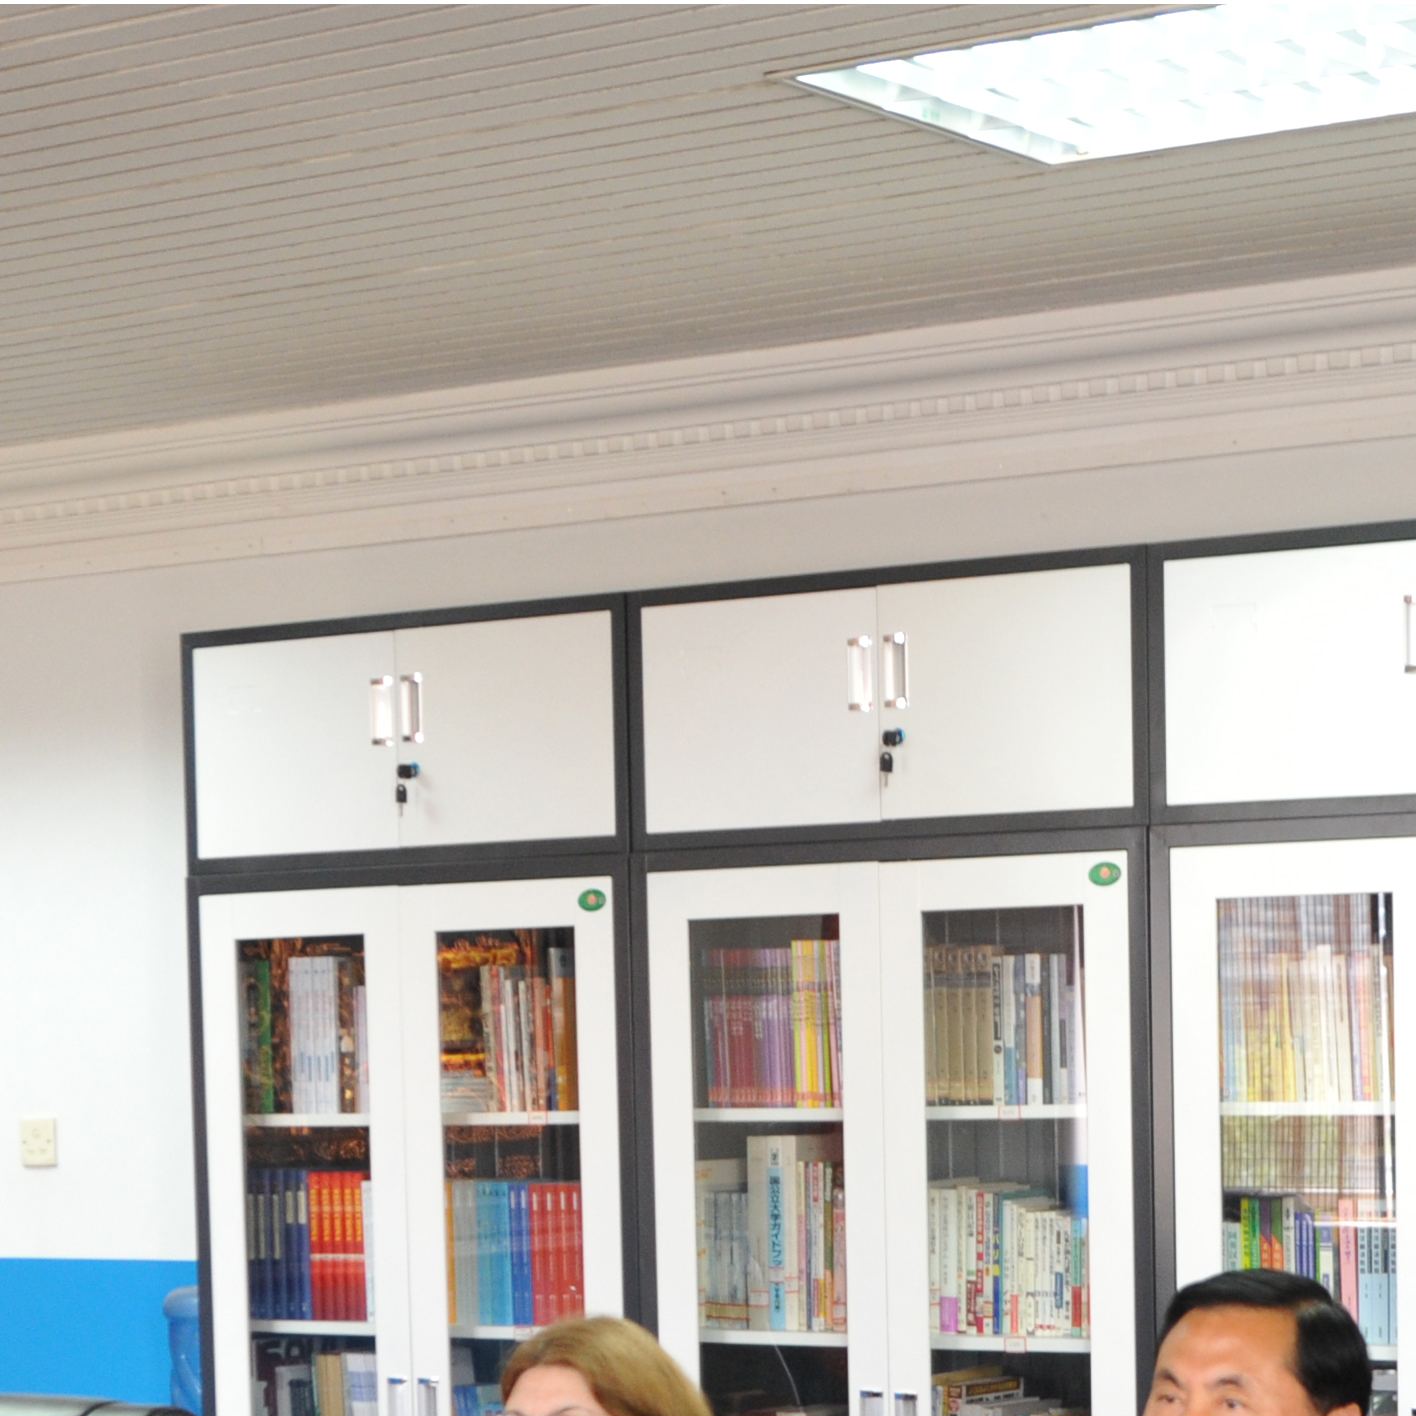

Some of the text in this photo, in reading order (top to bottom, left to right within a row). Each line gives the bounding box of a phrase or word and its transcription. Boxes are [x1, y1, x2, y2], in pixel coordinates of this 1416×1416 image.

[769, 1175, 783, 1267] 国公立大学ガイドブッ
